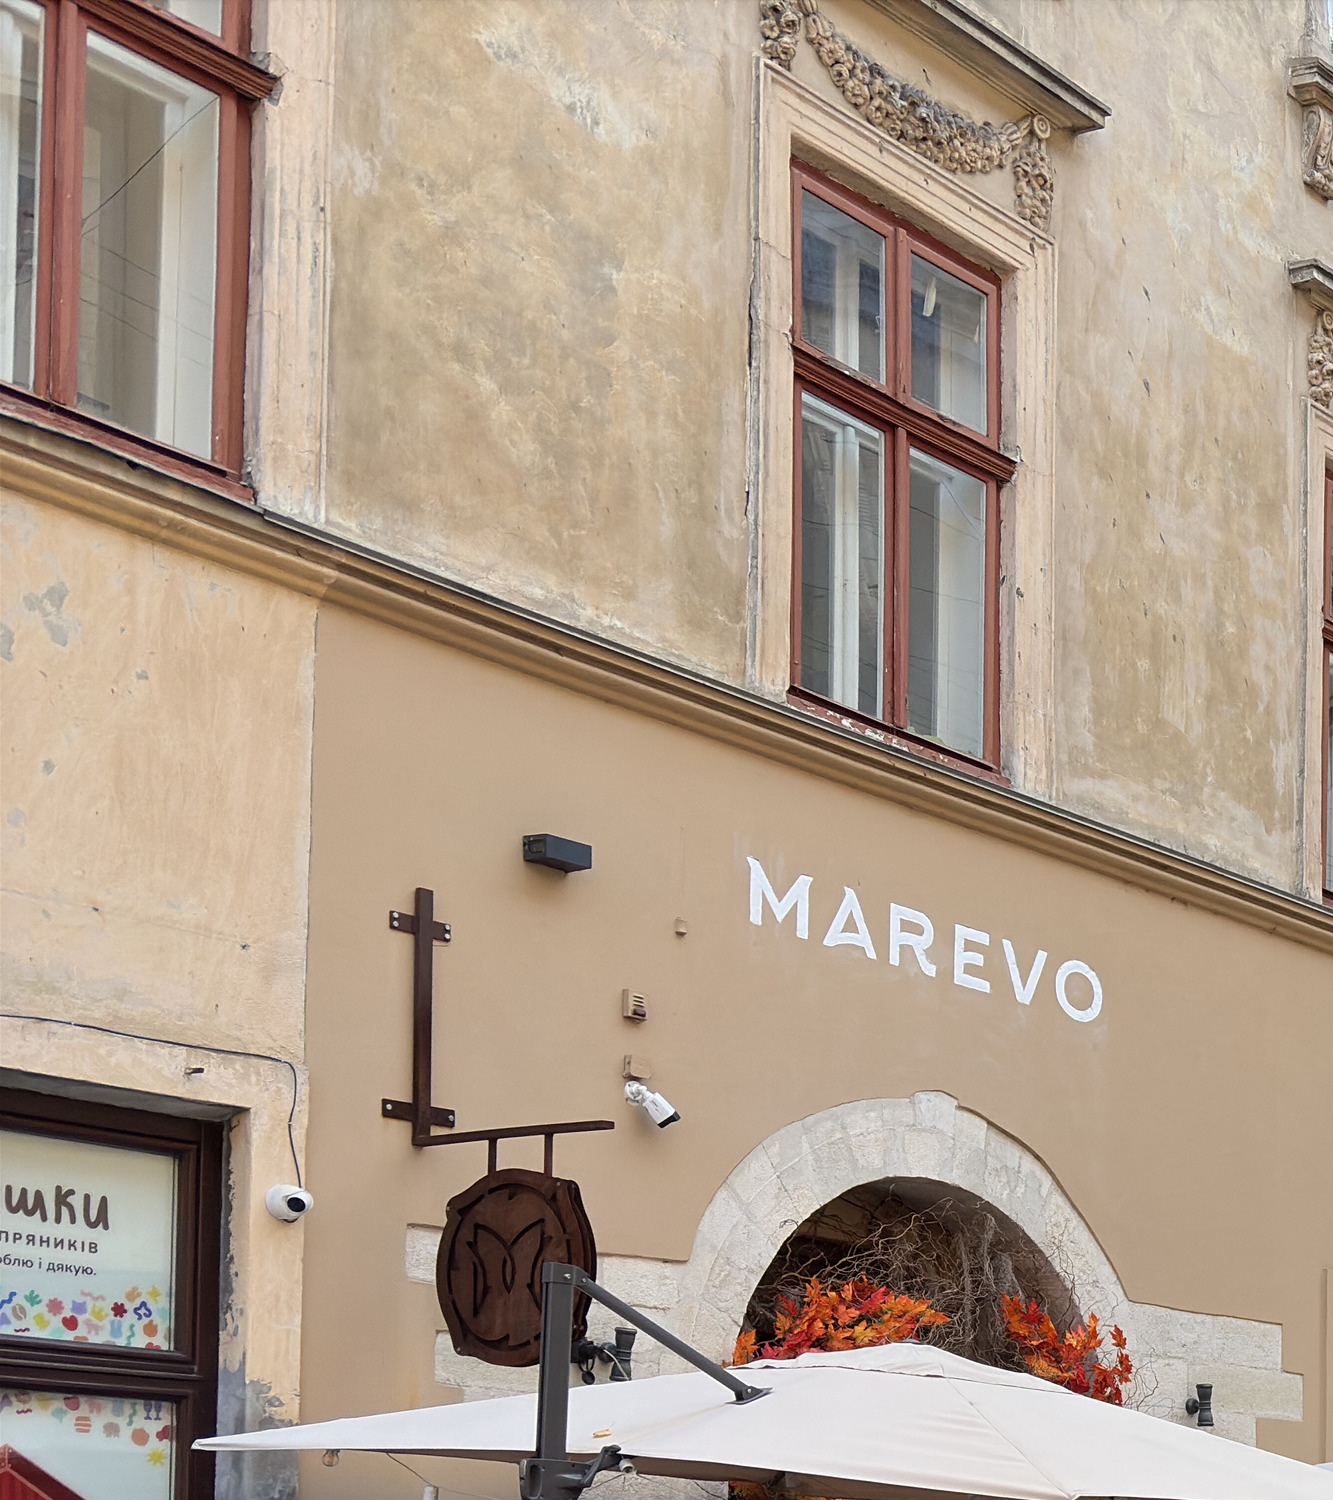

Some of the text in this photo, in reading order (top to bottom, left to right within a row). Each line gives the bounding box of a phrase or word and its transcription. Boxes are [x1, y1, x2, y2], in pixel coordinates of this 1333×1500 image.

[745, 855, 1104, 1024] MAREVO
[0, 1253, 97, 1276] блю і дякую.
